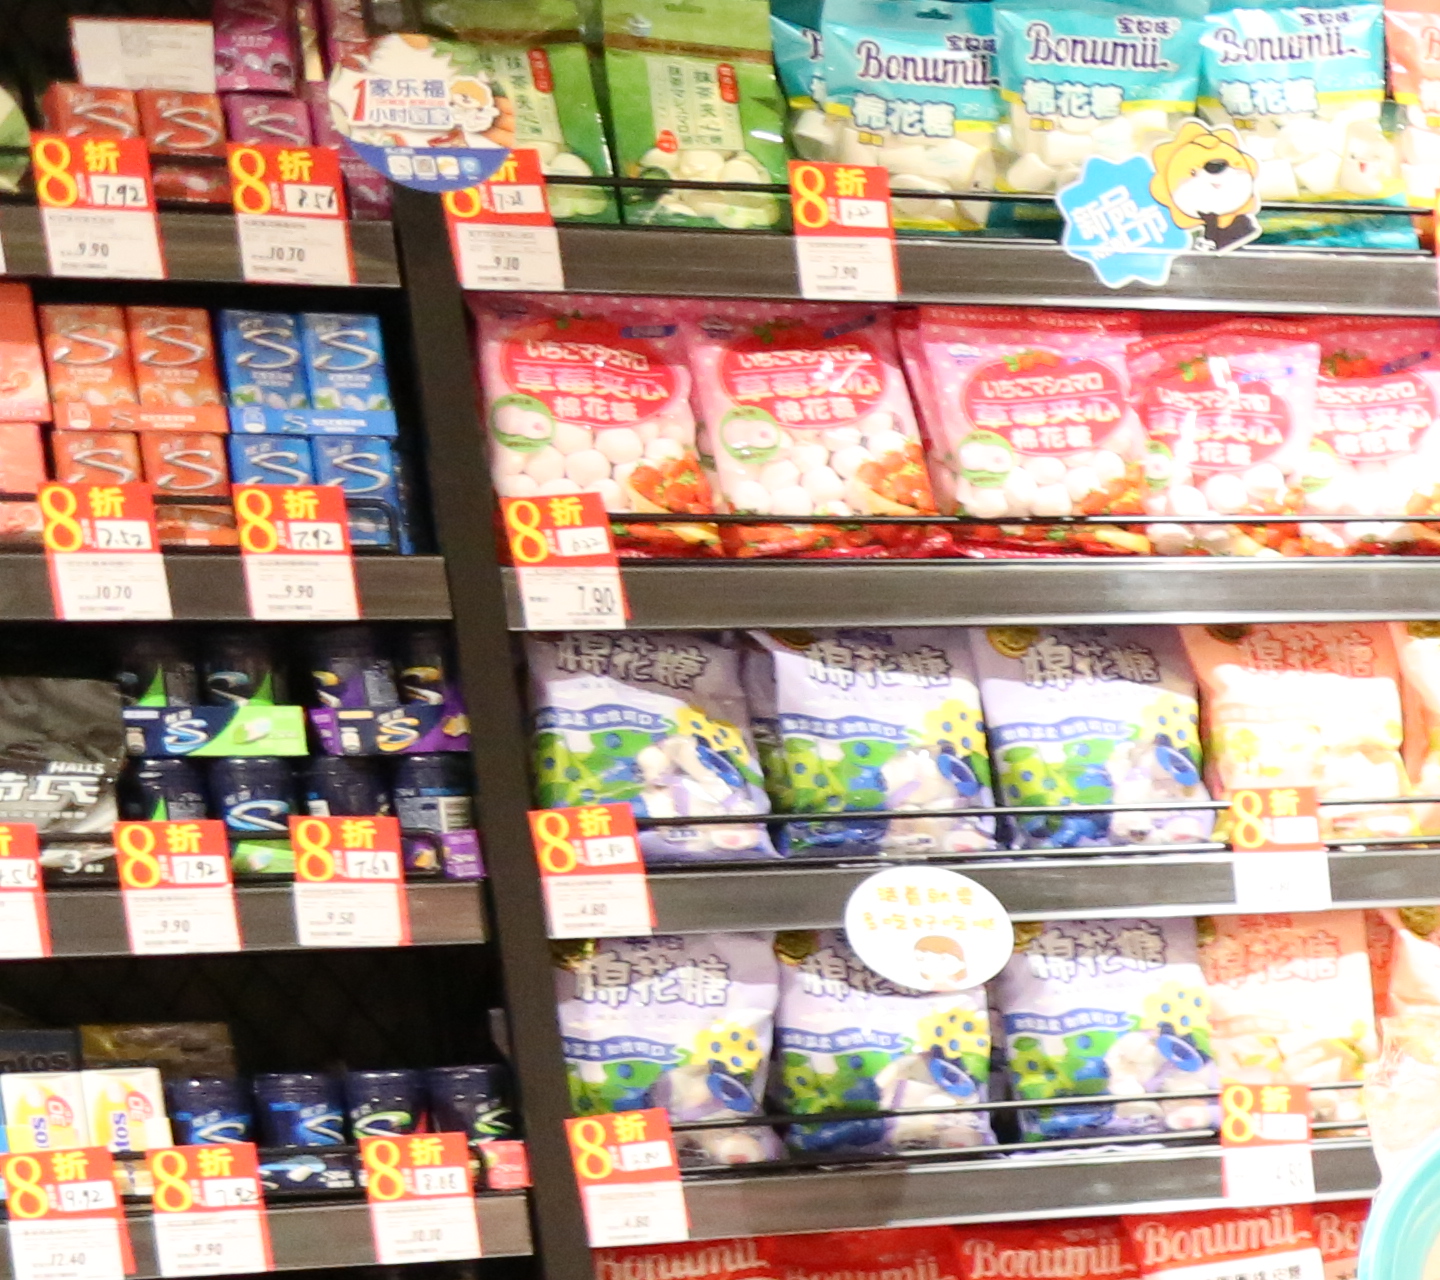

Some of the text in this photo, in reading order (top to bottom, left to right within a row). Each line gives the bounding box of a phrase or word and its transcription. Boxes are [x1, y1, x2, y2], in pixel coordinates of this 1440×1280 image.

[368, 79, 446, 98] 家乐福
[1022, 79, 1124, 120] 棉花糖
[517, 366, 669, 400] 草莓夹心
[736, 367, 882, 400] 草莓夹心
[553, 396, 639, 421] 棉花糖
[776, 398, 857, 422] 棉花糖
[577, 586, 616, 615] 7.90
[555, 632, 708, 688] 棉花糖
[803, 638, 952, 689] 棉花糖
[1020, 633, 1162, 686] 棉花糖
[49, 762, 106, 776] HALLS
[1134, 1208, 1312, 1268] Bonumii
